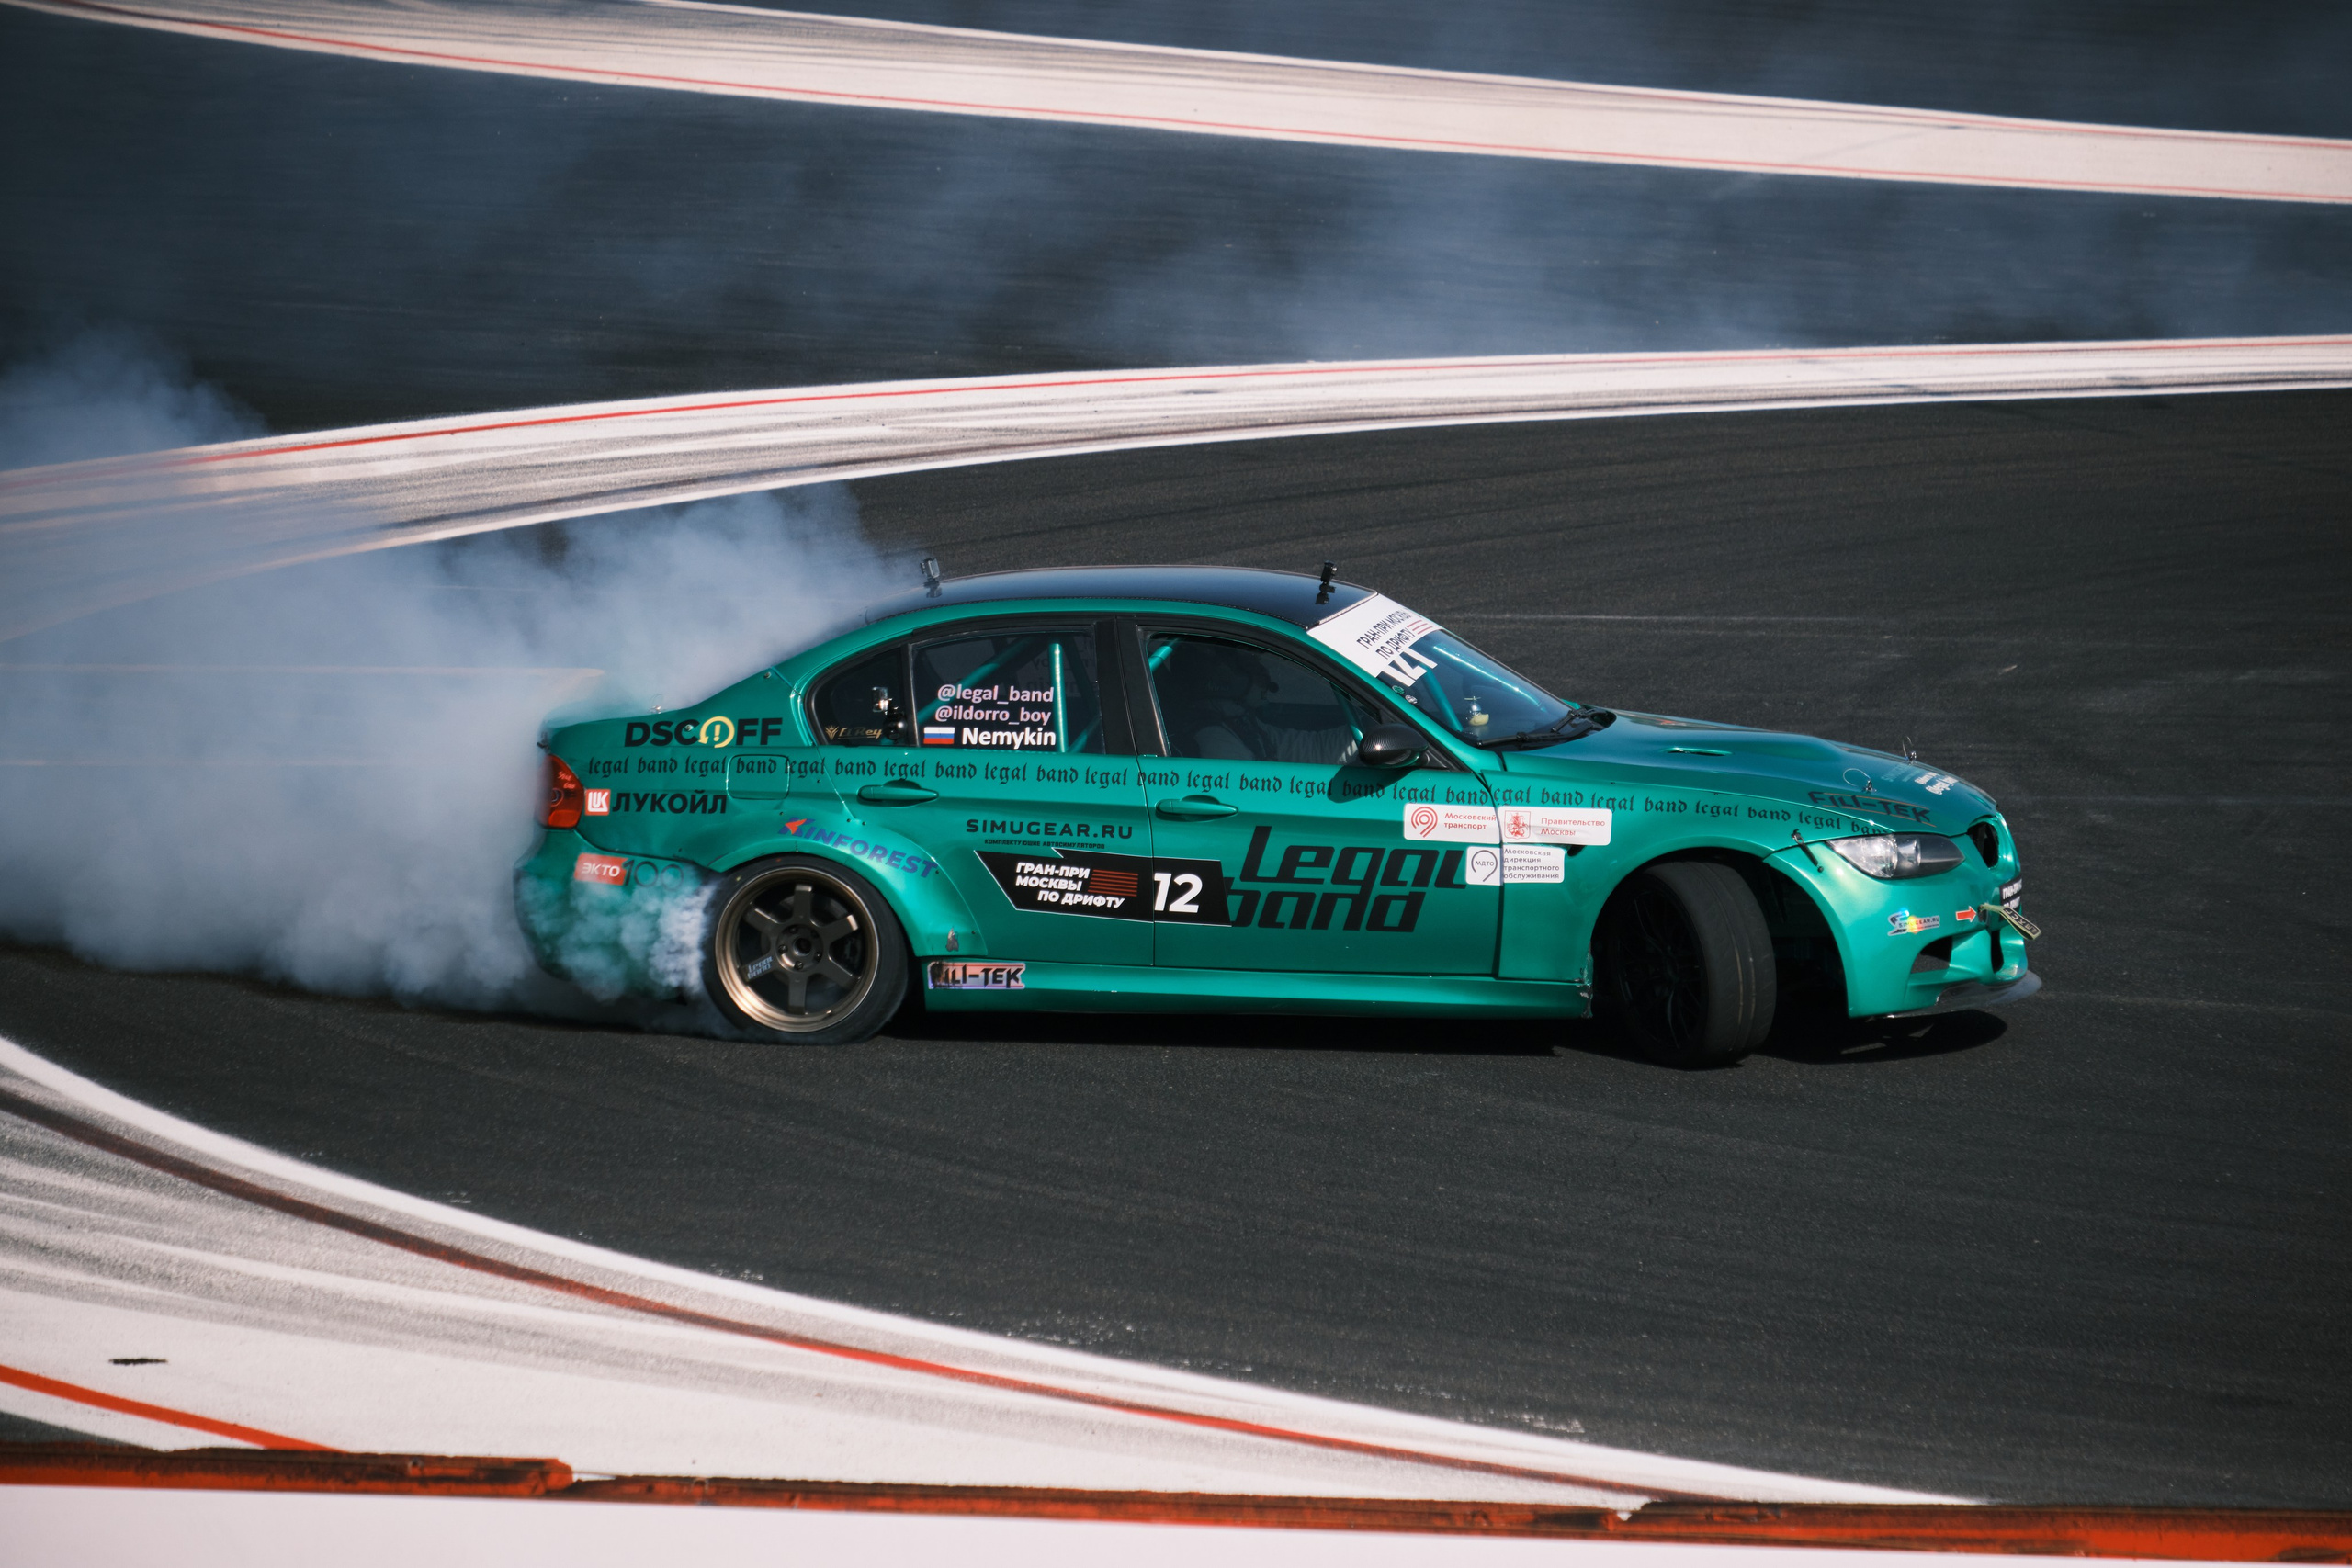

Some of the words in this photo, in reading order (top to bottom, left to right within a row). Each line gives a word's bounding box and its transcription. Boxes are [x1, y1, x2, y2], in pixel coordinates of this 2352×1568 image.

[1375, 646, 1394, 660] ПО
[937, 684, 1054, 705] @legal_band
[934, 705, 1051, 726] @ildorro_boy
[962, 727, 1056, 749] Nemykin
[588, 755, 629, 779] legal
[638, 756, 678, 774] band
[736, 757, 777, 774] band
[834, 758, 876, 776] band
[883, 759, 926, 781] legal
[935, 761, 977, 780] band
[984, 761, 1027, 785] legal
[1036, 763, 1079, 784] band
[1084, 766, 1128, 789] legal
[1186, 769, 1230, 793] legal
[1238, 773, 1282, 793] band
[1289, 774, 1333, 798] legal
[1342, 779, 1385, 800] band
[1392, 781, 1436, 804] legal
[1445, 785, 1489, 806] band
[1541, 787, 1584, 806] band
[1644, 795, 1687, 813] band
[1694, 799, 1739, 818] legal
[1747, 801, 1791, 822] band
[1798, 807, 1841, 829] legal
[1849, 817, 1889, 835] ban
[612, 789, 727, 815] ЛУКОЙЛ
[1444, 813, 1497, 821] Московский
[1807, 790, 1930, 823] FILI-TEK
[966, 818, 1132, 840] SIMUGEAR.RU
[1443, 822, 1487, 830] транспорт
[1541, 818, 1606, 827] Правительство
[1541, 828, 1576, 836] Москвы
[777, 817, 939, 878] KINFOREST
[1239, 825, 1467, 889] Legal
[1504, 848, 1551, 856] Московская
[581, 862, 621, 877] ЭКТО
[622, 859, 684, 891] 100
[1016, 862, 1091, 879] ГРАН-ПРИ
[1503, 872, 1560, 880] обслуживания
[1015, 875, 1082, 891] МОСКВЫ
[1154, 873, 1203, 913] 12
[1037, 890, 1060, 903] ПО
[1061, 893, 1125, 908] ДРИФТУ
[1898, 917, 1940, 929] SIGEAR.RU
[930, 963, 1023, 988] ILI-TEK
